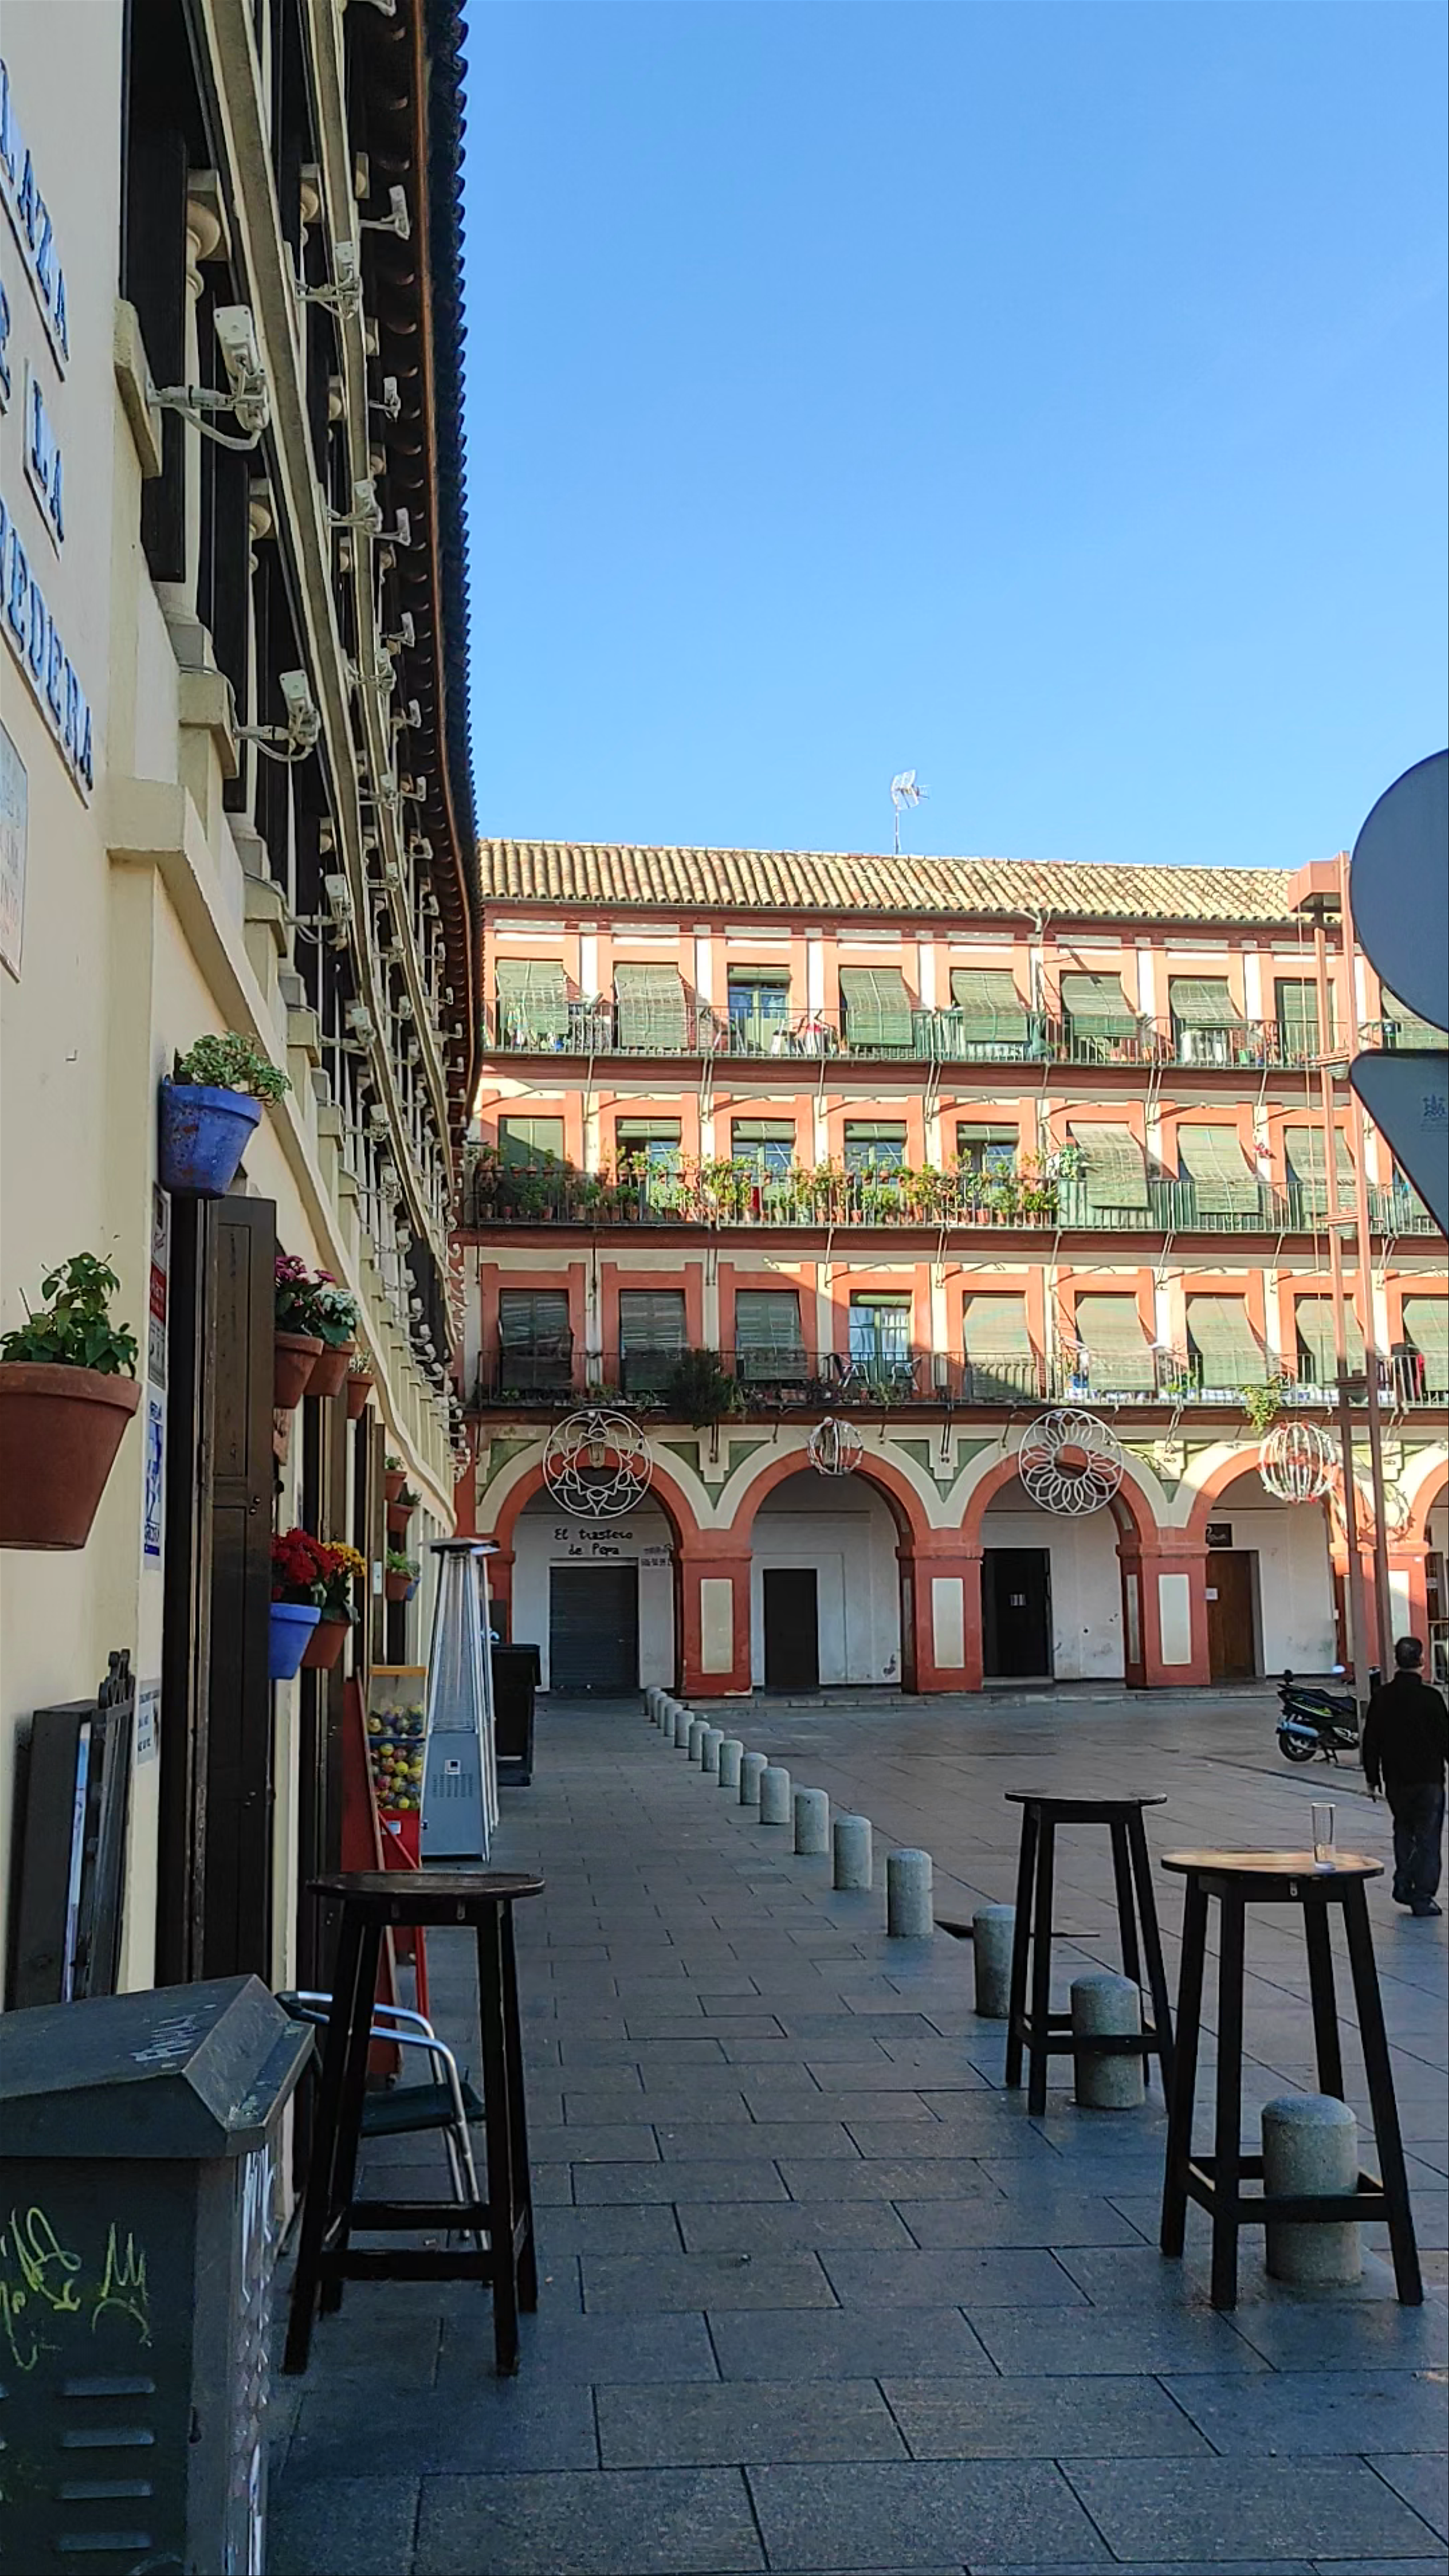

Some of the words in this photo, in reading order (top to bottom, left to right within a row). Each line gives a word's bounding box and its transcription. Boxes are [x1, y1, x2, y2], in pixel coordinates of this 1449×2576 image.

[31, 379, 64, 543] LA
[0, 496, 94, 791] EDERA
[554, 1528, 569, 1540] El
[578, 1528, 633, 1540] trastero
[568, 1544, 582, 1555] de
[592, 1543, 620, 1556] Pepa
